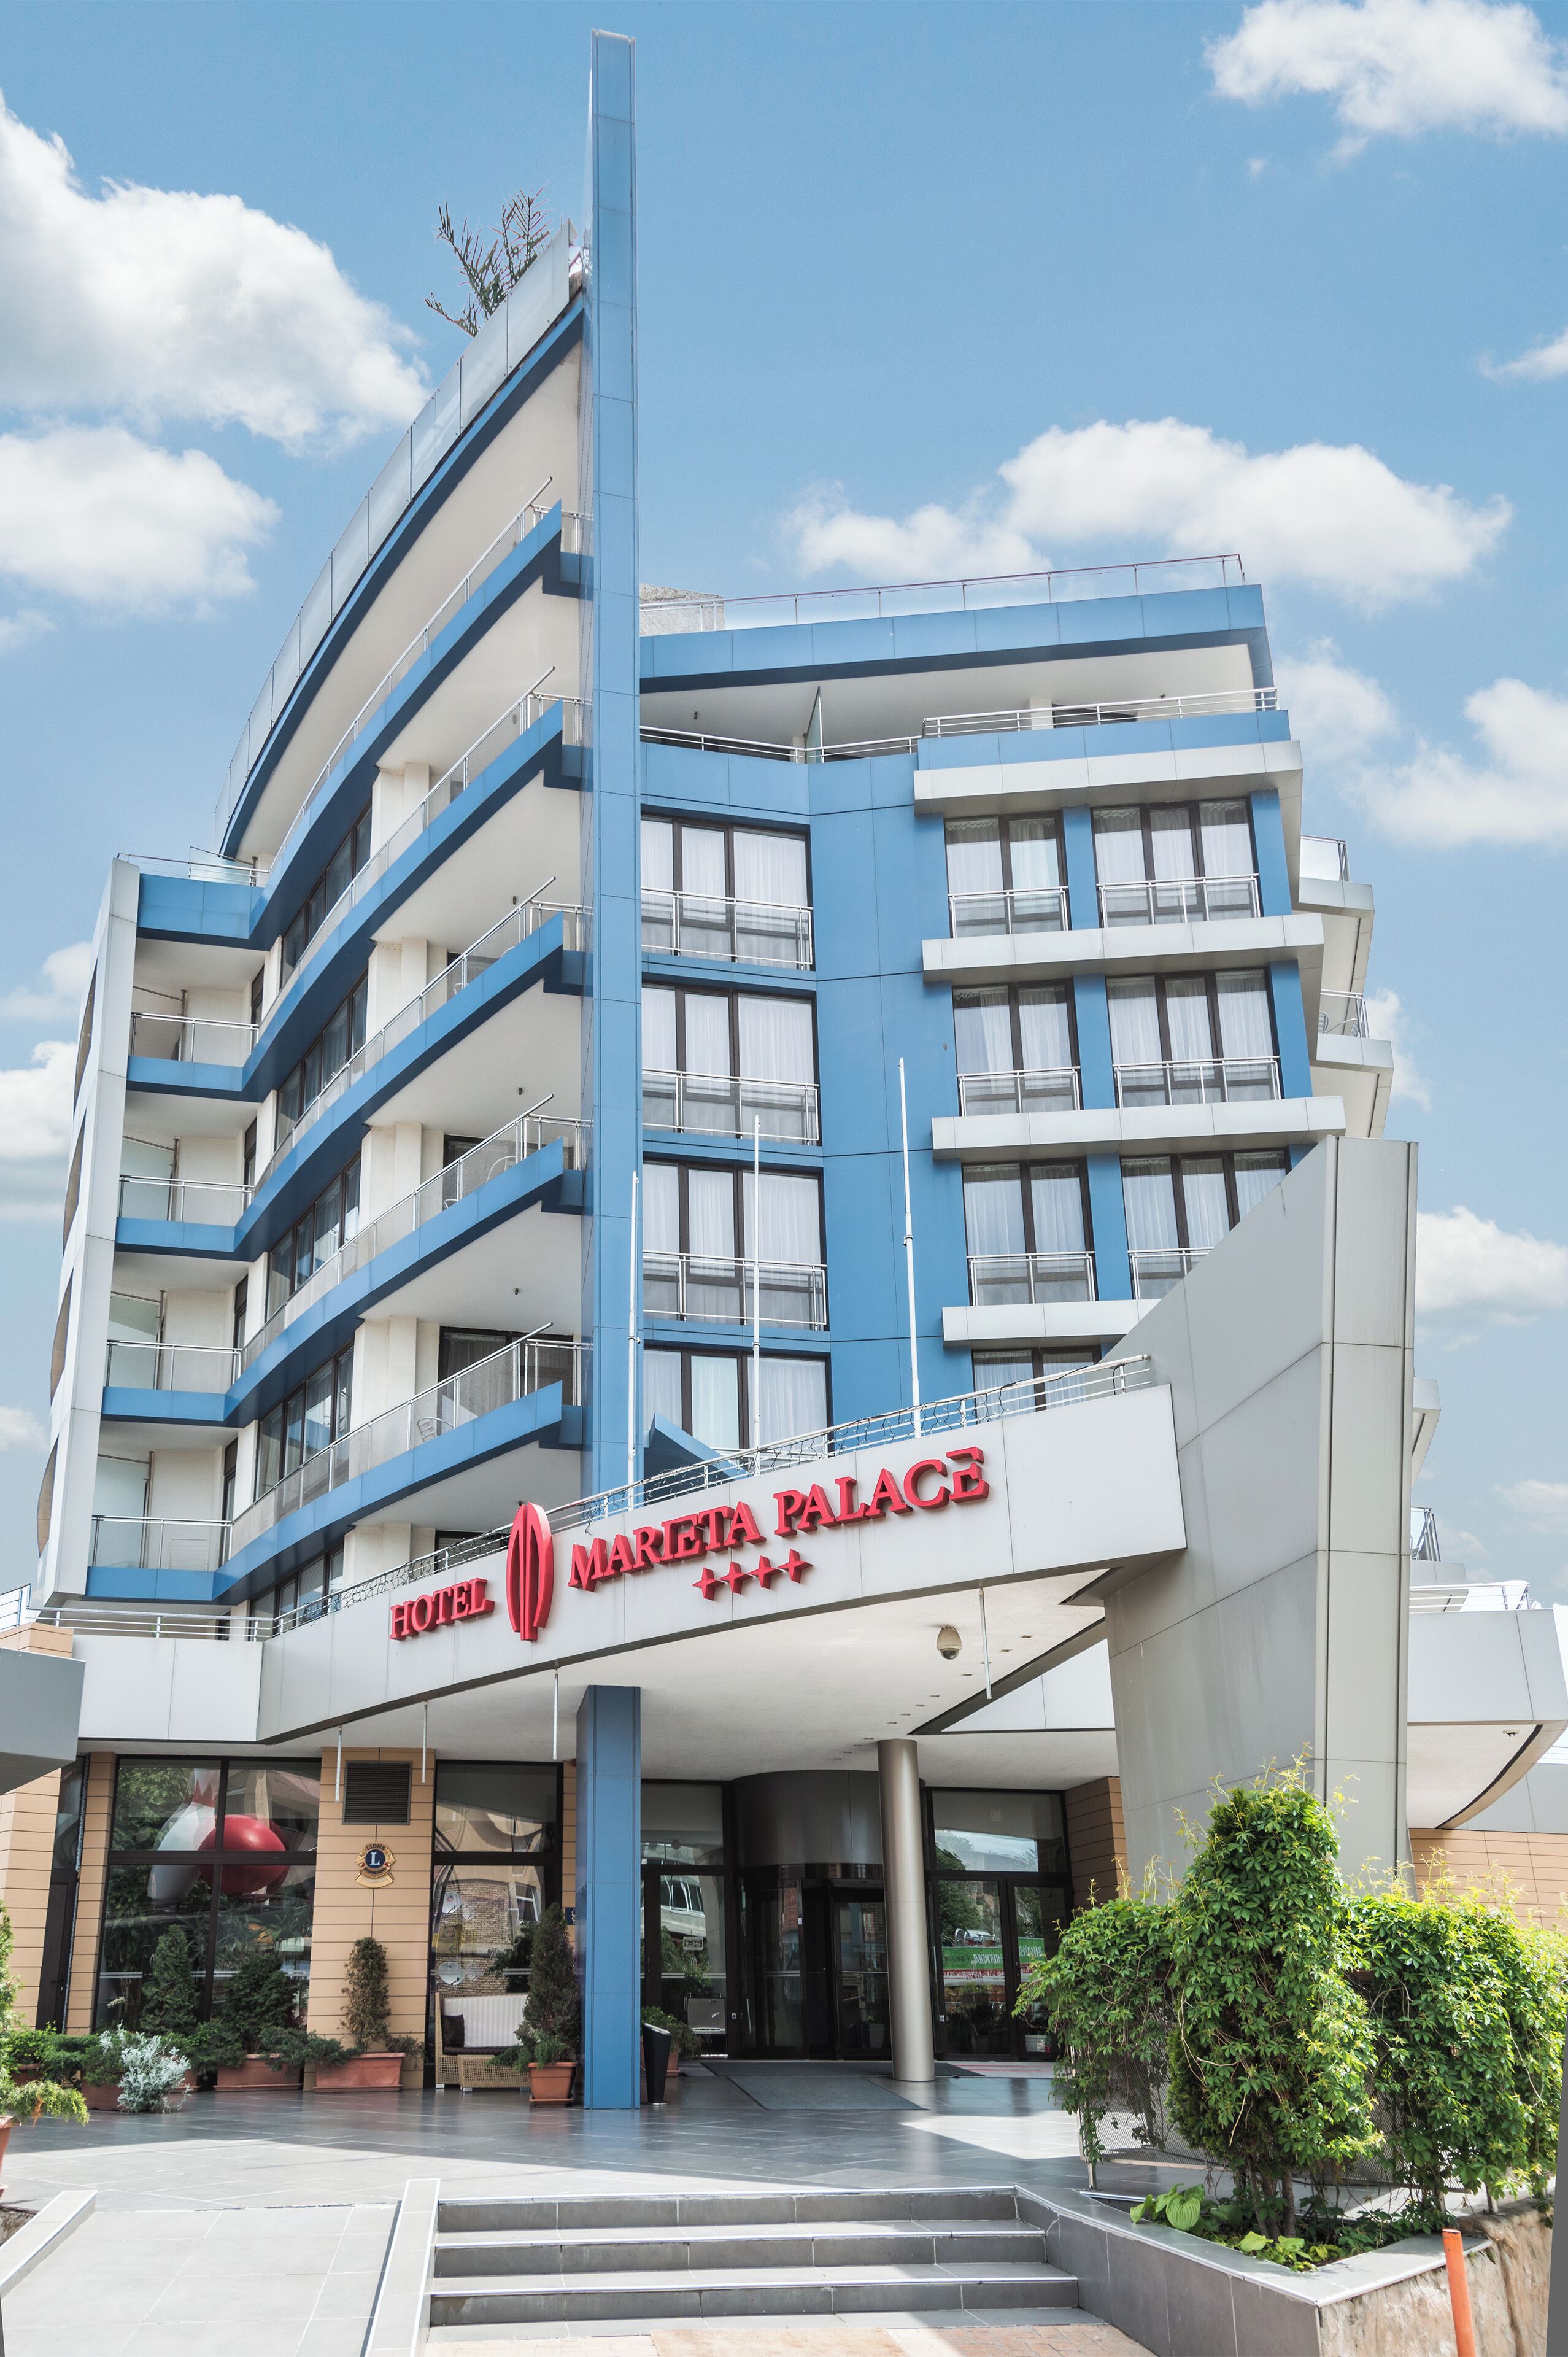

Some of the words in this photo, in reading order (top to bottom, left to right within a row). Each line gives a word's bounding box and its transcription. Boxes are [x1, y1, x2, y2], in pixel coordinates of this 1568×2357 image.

[390, 1577, 495, 1641] HOTEL
[566, 1501, 766, 1592] MARIETA
[772, 1446, 989, 1537] PALACE
[369, 1852, 380, 1865] L
